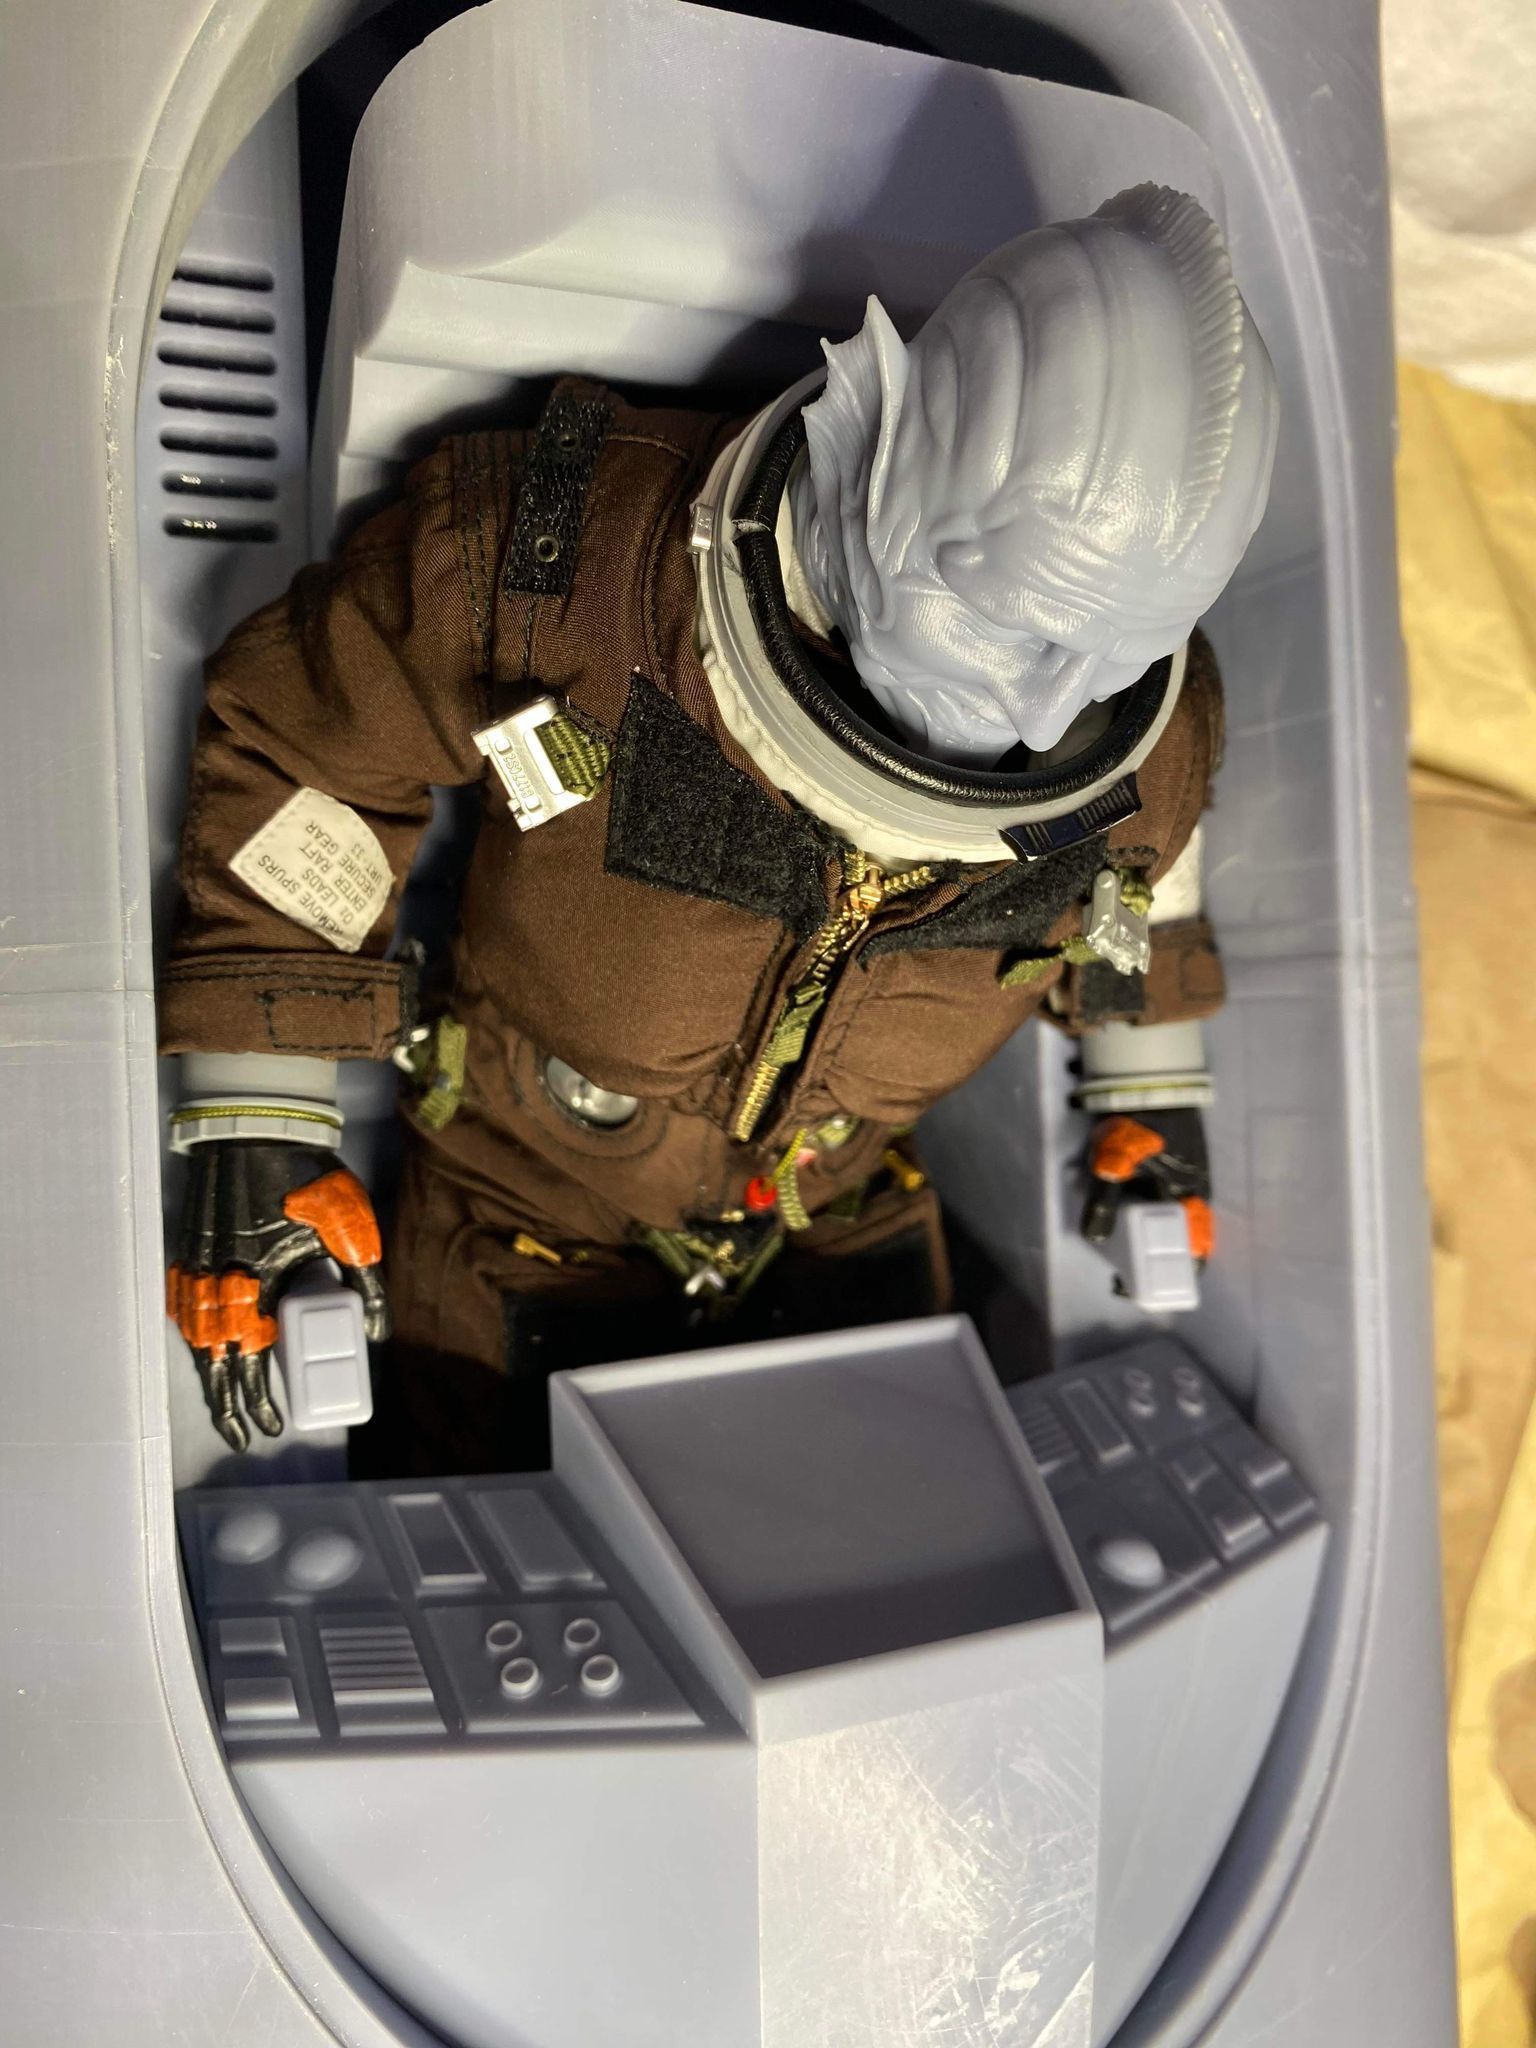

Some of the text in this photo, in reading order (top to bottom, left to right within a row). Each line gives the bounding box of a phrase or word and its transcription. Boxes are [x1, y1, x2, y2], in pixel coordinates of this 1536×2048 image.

[258, 854, 301, 894] SPURS
[299, 842, 367, 912] ENTER RAFT
[305, 820, 377, 898] SECURE GEAR
[302, 868, 339, 907] LEADS
